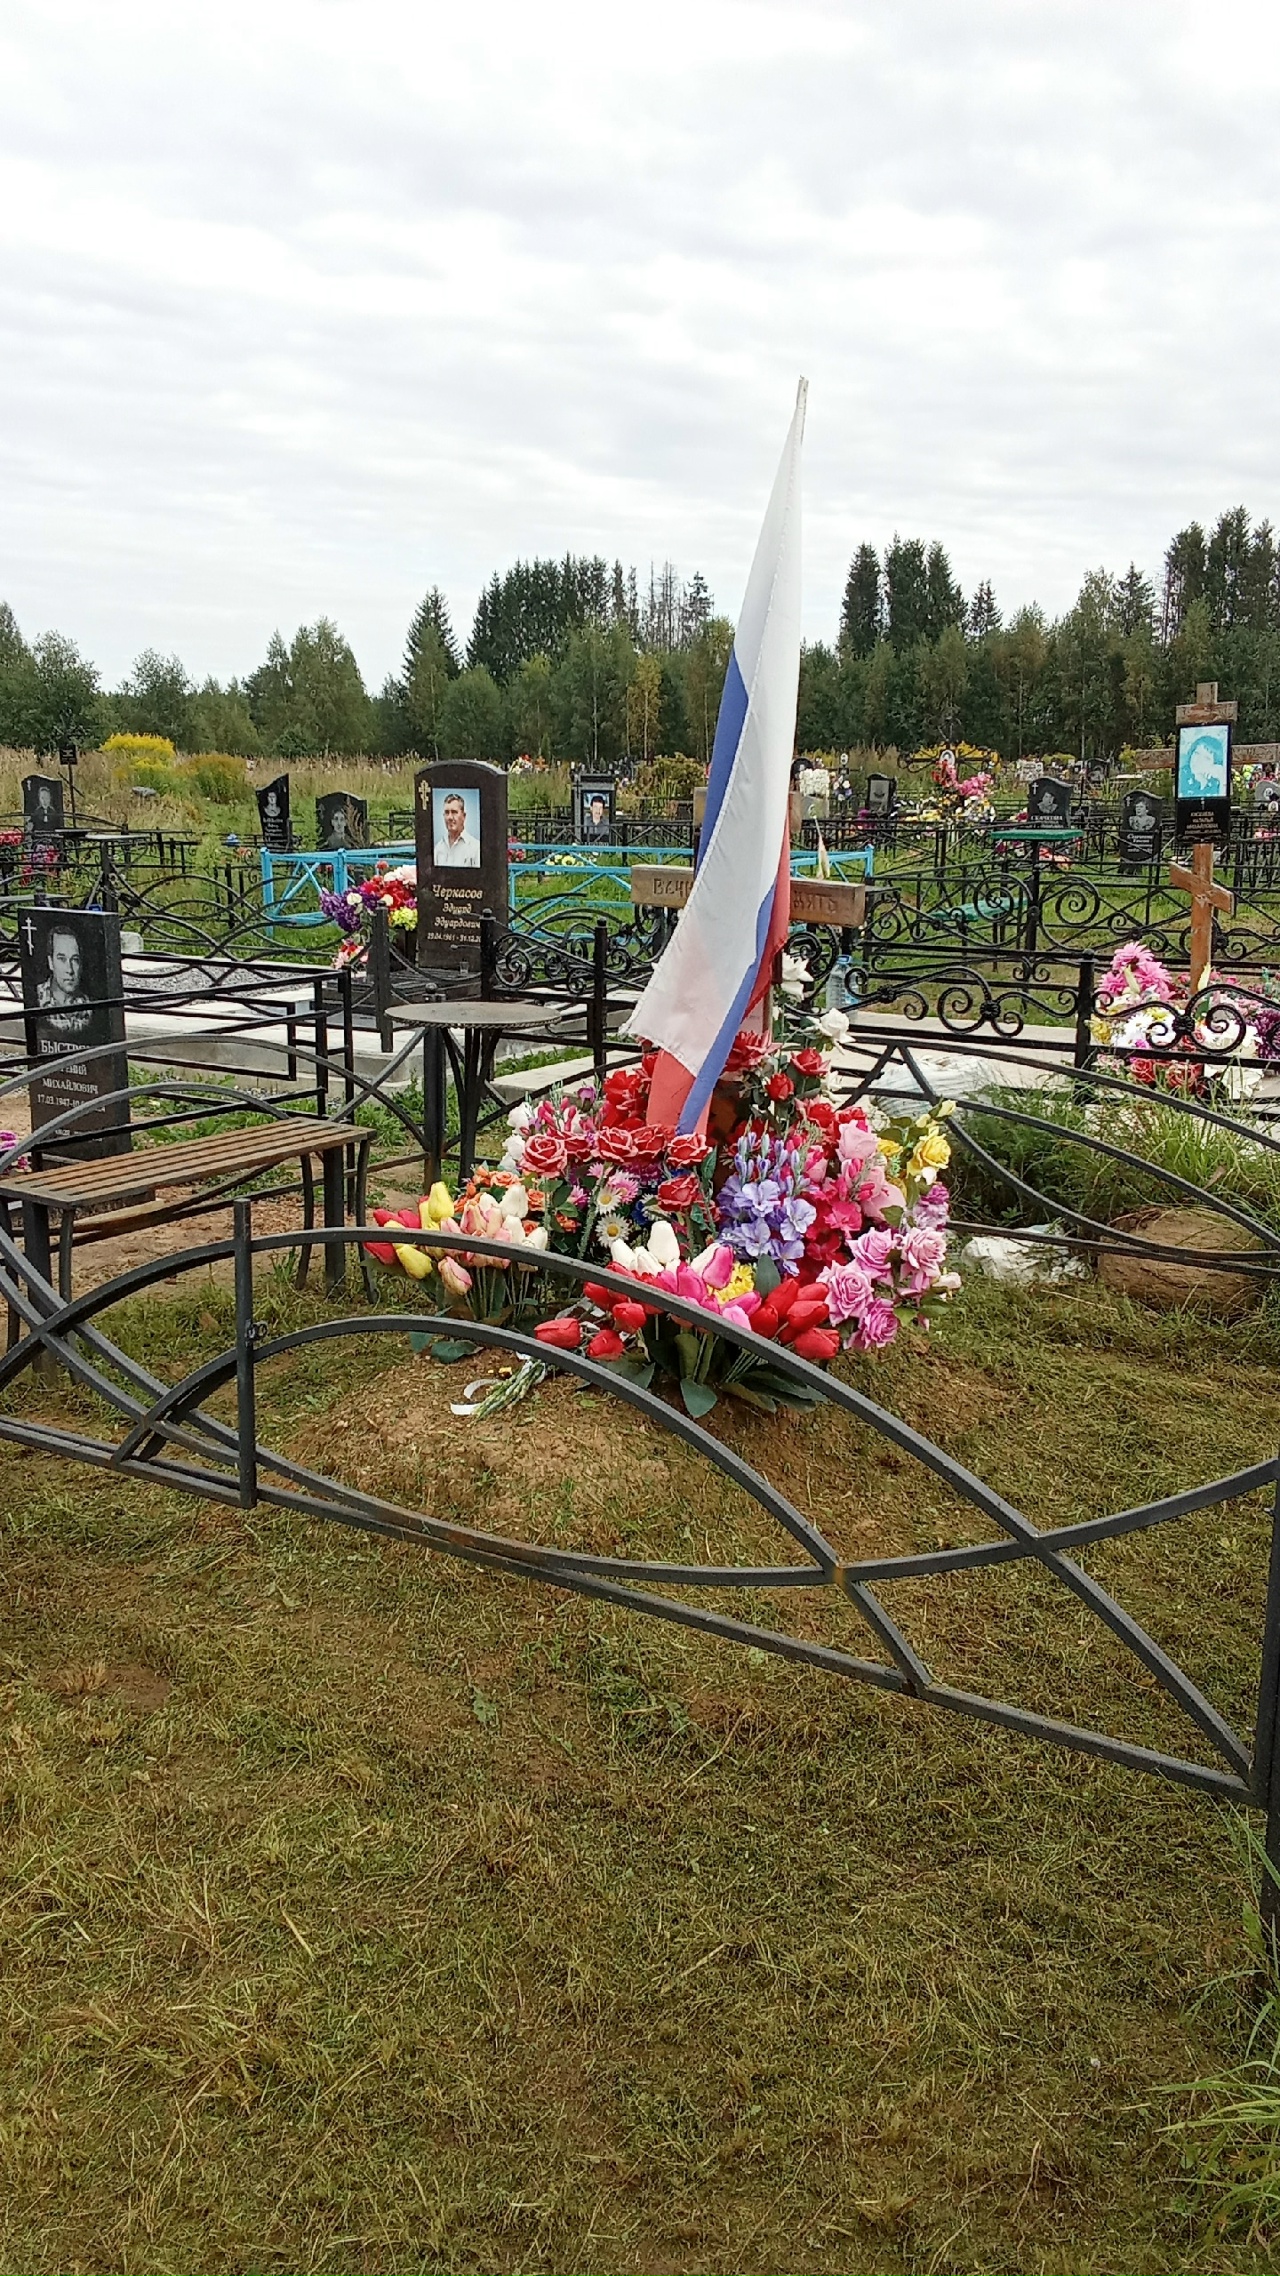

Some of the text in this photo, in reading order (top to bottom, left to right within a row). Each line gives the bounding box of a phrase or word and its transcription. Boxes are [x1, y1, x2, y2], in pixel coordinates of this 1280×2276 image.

[432, 884, 483, 900] Черкасов
[653, 878, 694, 898] ВЕЧН
[442, 902, 472, 915] Эдуард
[42, 1078, 99, 1095] МИХАЙЛОВИЧ
